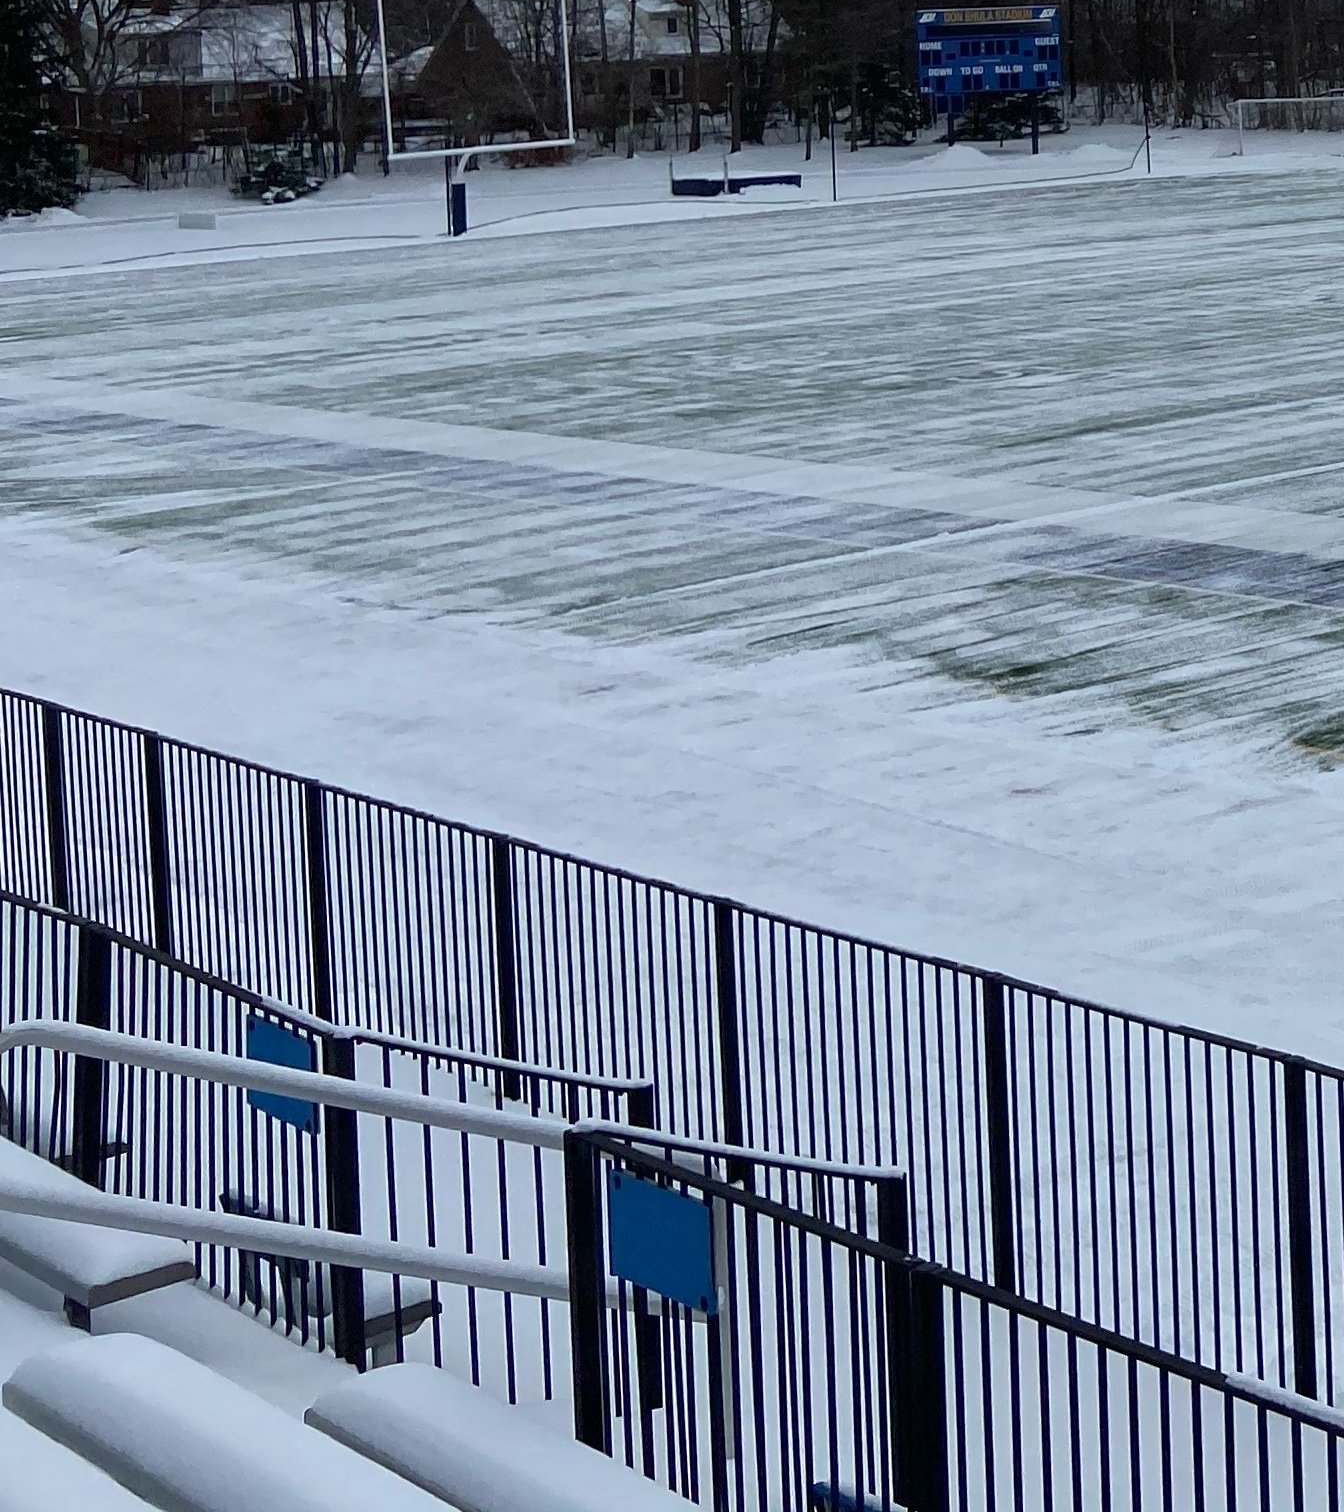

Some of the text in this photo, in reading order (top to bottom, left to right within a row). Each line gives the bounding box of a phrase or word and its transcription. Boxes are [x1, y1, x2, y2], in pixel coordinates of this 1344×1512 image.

[965, 11, 994, 22] SHULA
[995, 9, 1033, 21] STADIUM
[919, 42, 942, 50] HOME
[1034, 37, 1060, 46] GUEST
[928, 68, 953, 76] DOWN
[960, 66, 984, 75] TO GO
[995, 64, 1023, 74] BALL ON
[1033, 63, 1048, 72] QTR
